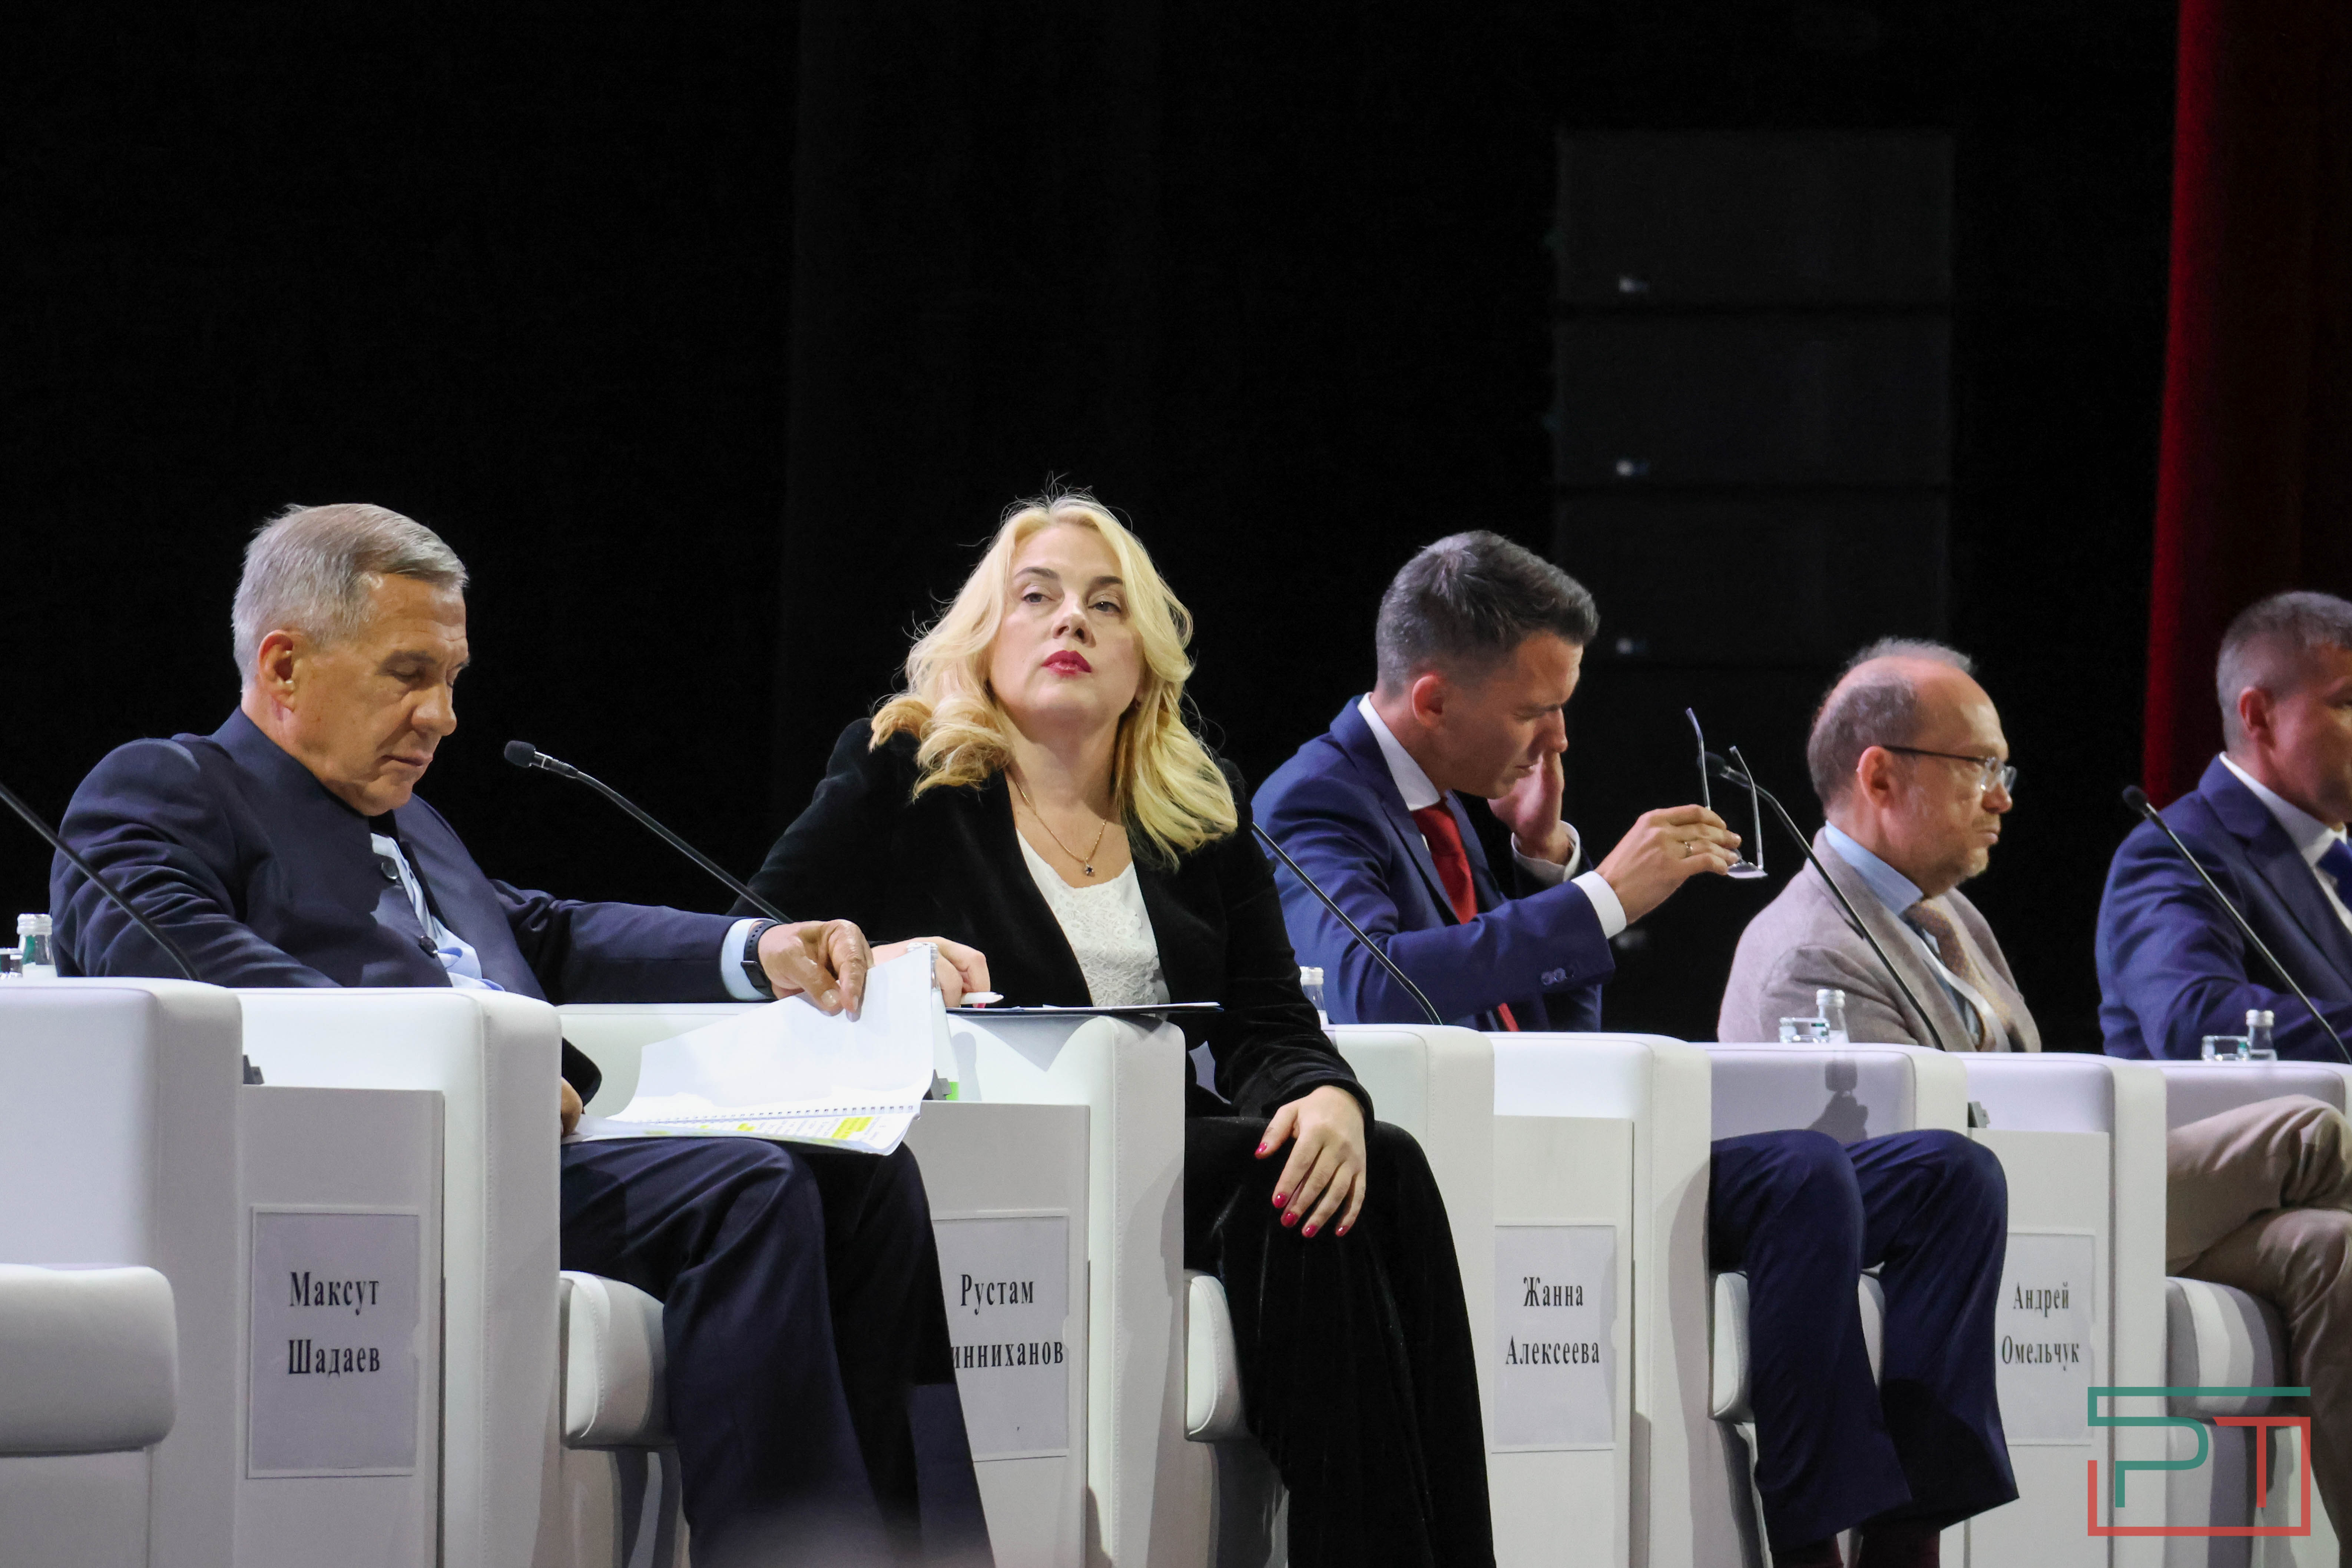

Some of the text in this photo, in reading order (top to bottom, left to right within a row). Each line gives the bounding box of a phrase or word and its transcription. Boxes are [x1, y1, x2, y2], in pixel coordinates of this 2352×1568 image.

[290, 1272, 380, 1316] Максут
[961, 1274, 1034, 1315] Рустам
[1523, 1277, 1583, 1306] Жанна
[2013, 1282, 2069, 1317] Андрей
[288, 1339, 380, 1377] Шадаев
[950, 1341, 1064, 1369] инниханов
[1505, 1335, 1600, 1365] Алексеева
[2002, 1335, 2079, 1371] Омельчук
